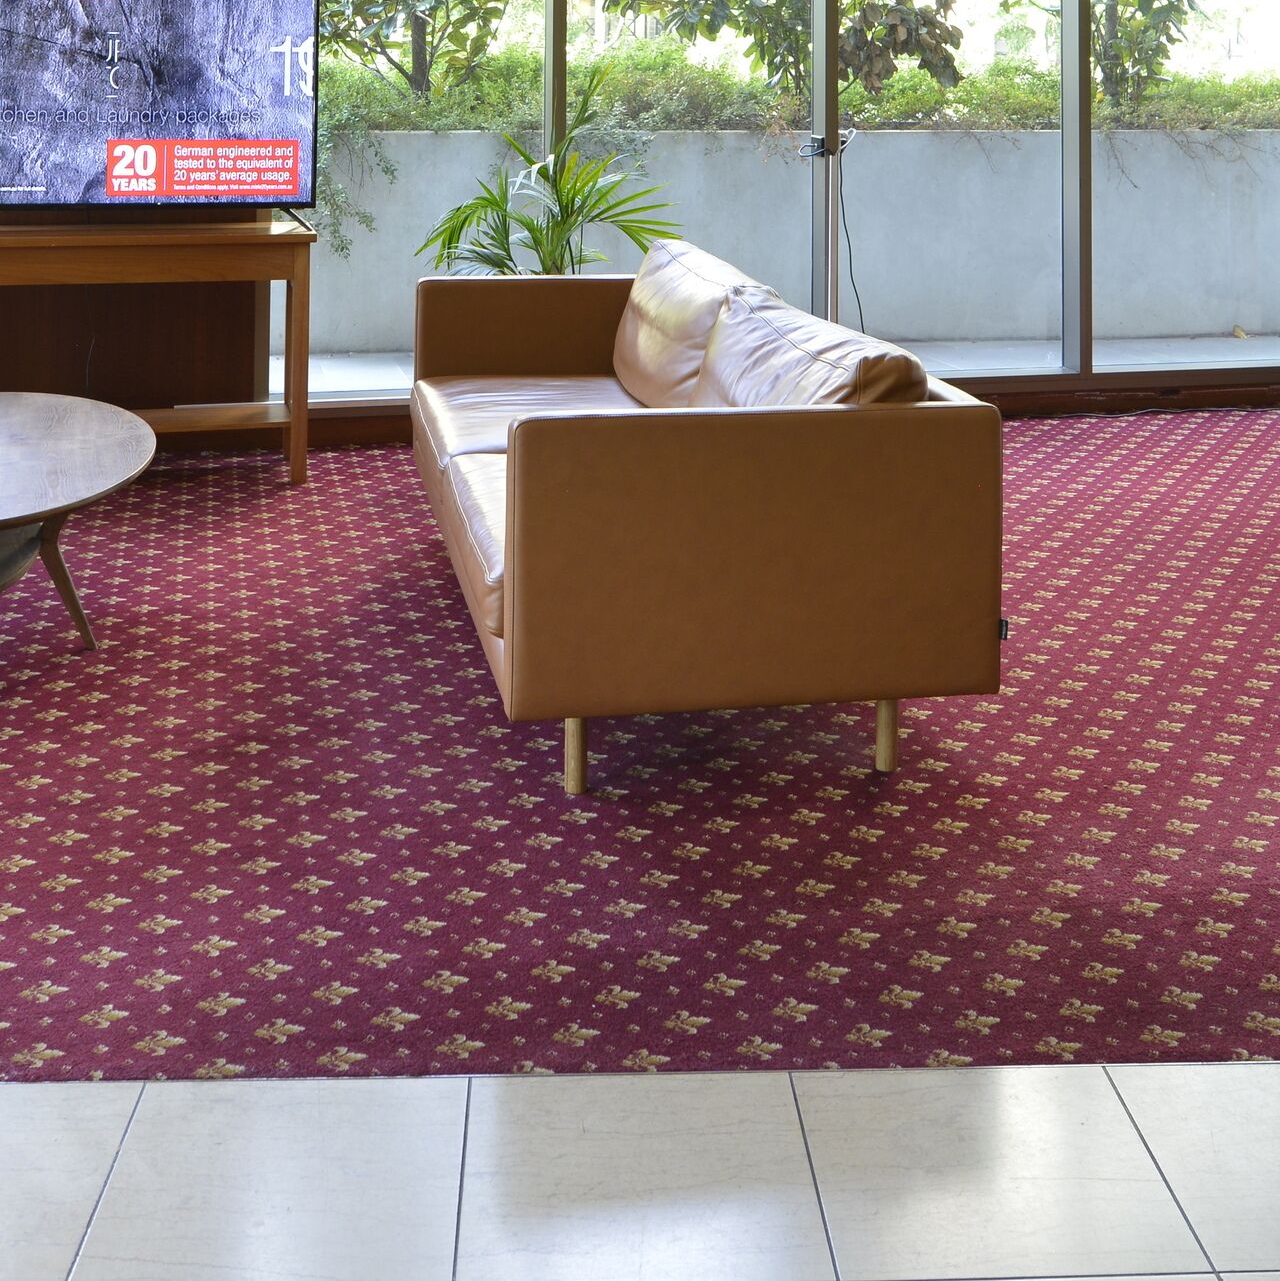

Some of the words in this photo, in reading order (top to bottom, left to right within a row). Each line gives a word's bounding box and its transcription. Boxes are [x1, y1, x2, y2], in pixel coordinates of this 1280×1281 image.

[54, 106, 89, 123] and
[96, 106, 170, 127] Laundry
[175, 106, 261, 126] packages
[174, 145, 214, 156] German
[216, 145, 272, 158] engineered
[274, 145, 293, 156] and
[112, 144, 157, 176] 20
[174, 157, 204, 168] tested
[206, 158, 216, 168] to
[218, 157, 233, 168] the
[236, 157, 282, 170] equivalent
[284, 157, 294, 168] of
[173, 170, 187, 181] 20
[219, 172, 258, 183] average
[261, 172, 293, 183] usage.
[112, 178, 157, 191] YEARS
